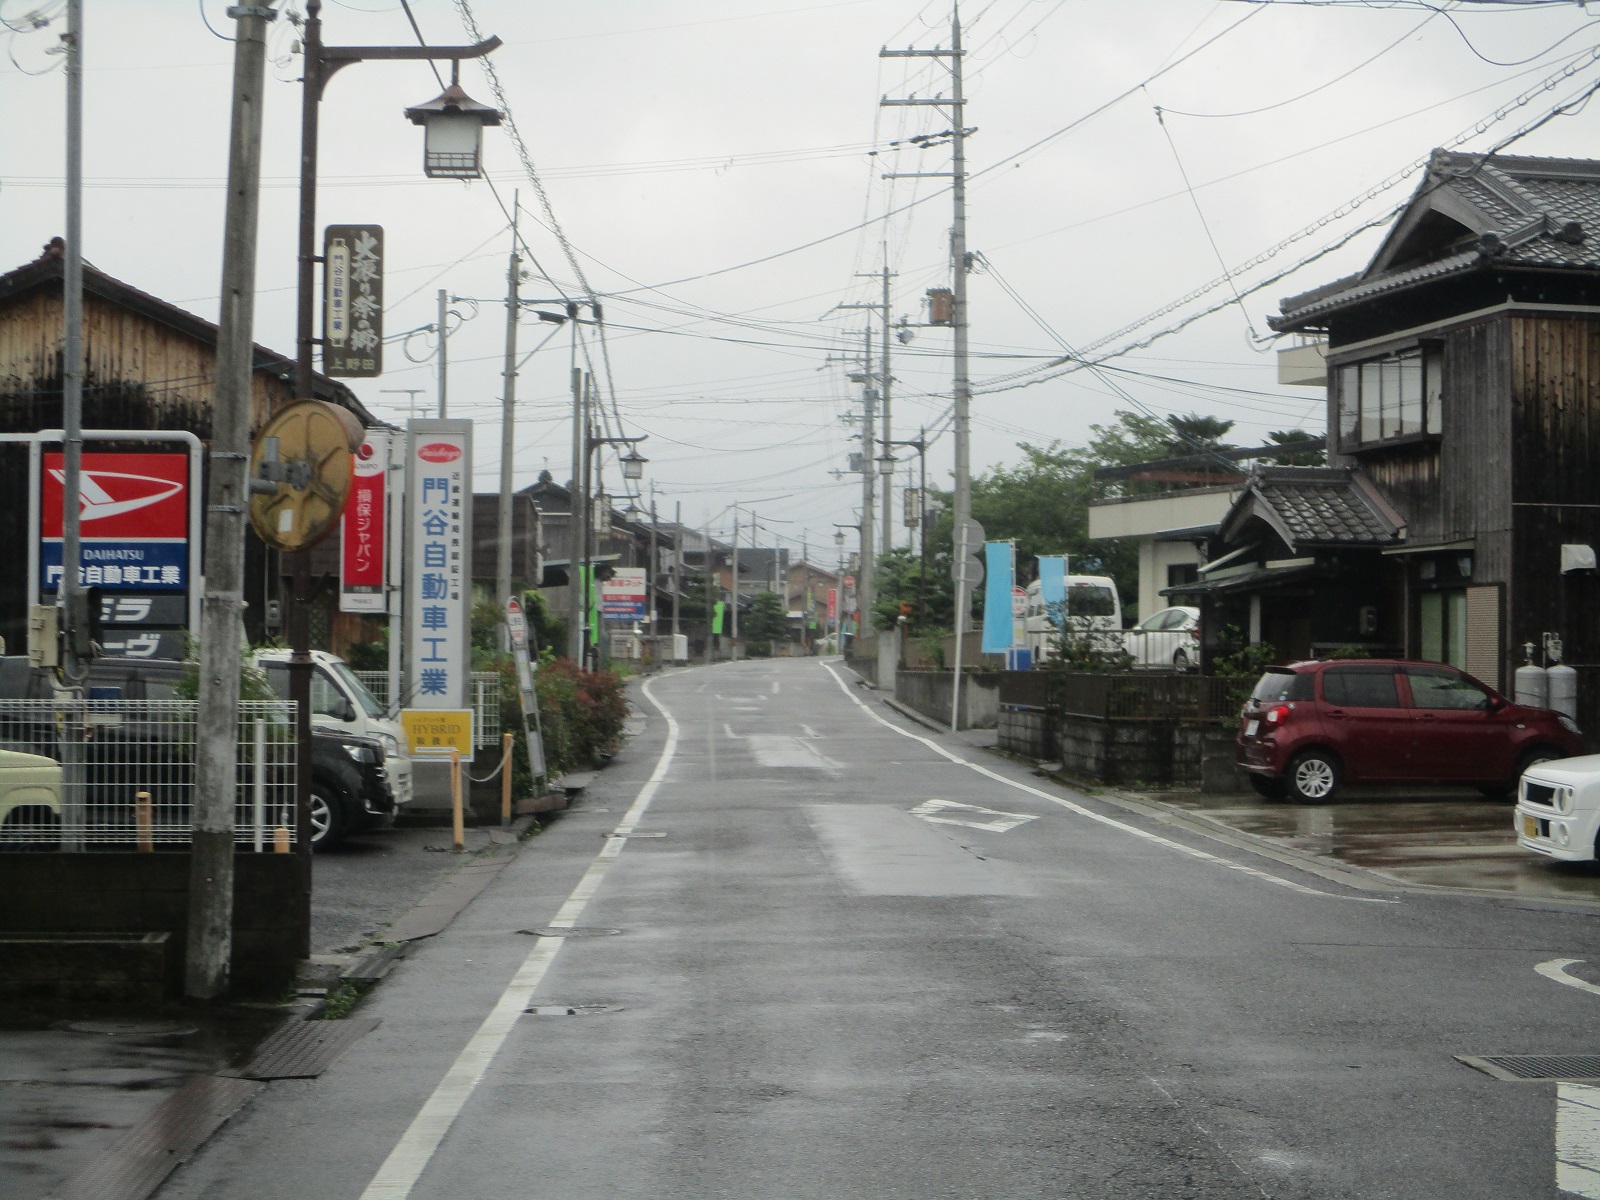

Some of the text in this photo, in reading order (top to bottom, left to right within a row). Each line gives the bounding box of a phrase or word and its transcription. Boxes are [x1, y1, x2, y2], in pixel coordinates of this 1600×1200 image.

[350, 230, 382, 354] 火振り祭の郷
[329, 357, 375, 371] 上野田
[83, 549, 144, 561] DAIHATSU
[355, 489, 373, 573] 損保ジャパン
[420, 477, 450, 696] 門谷自動車工業
[412, 724, 461, 735] HYBRID
